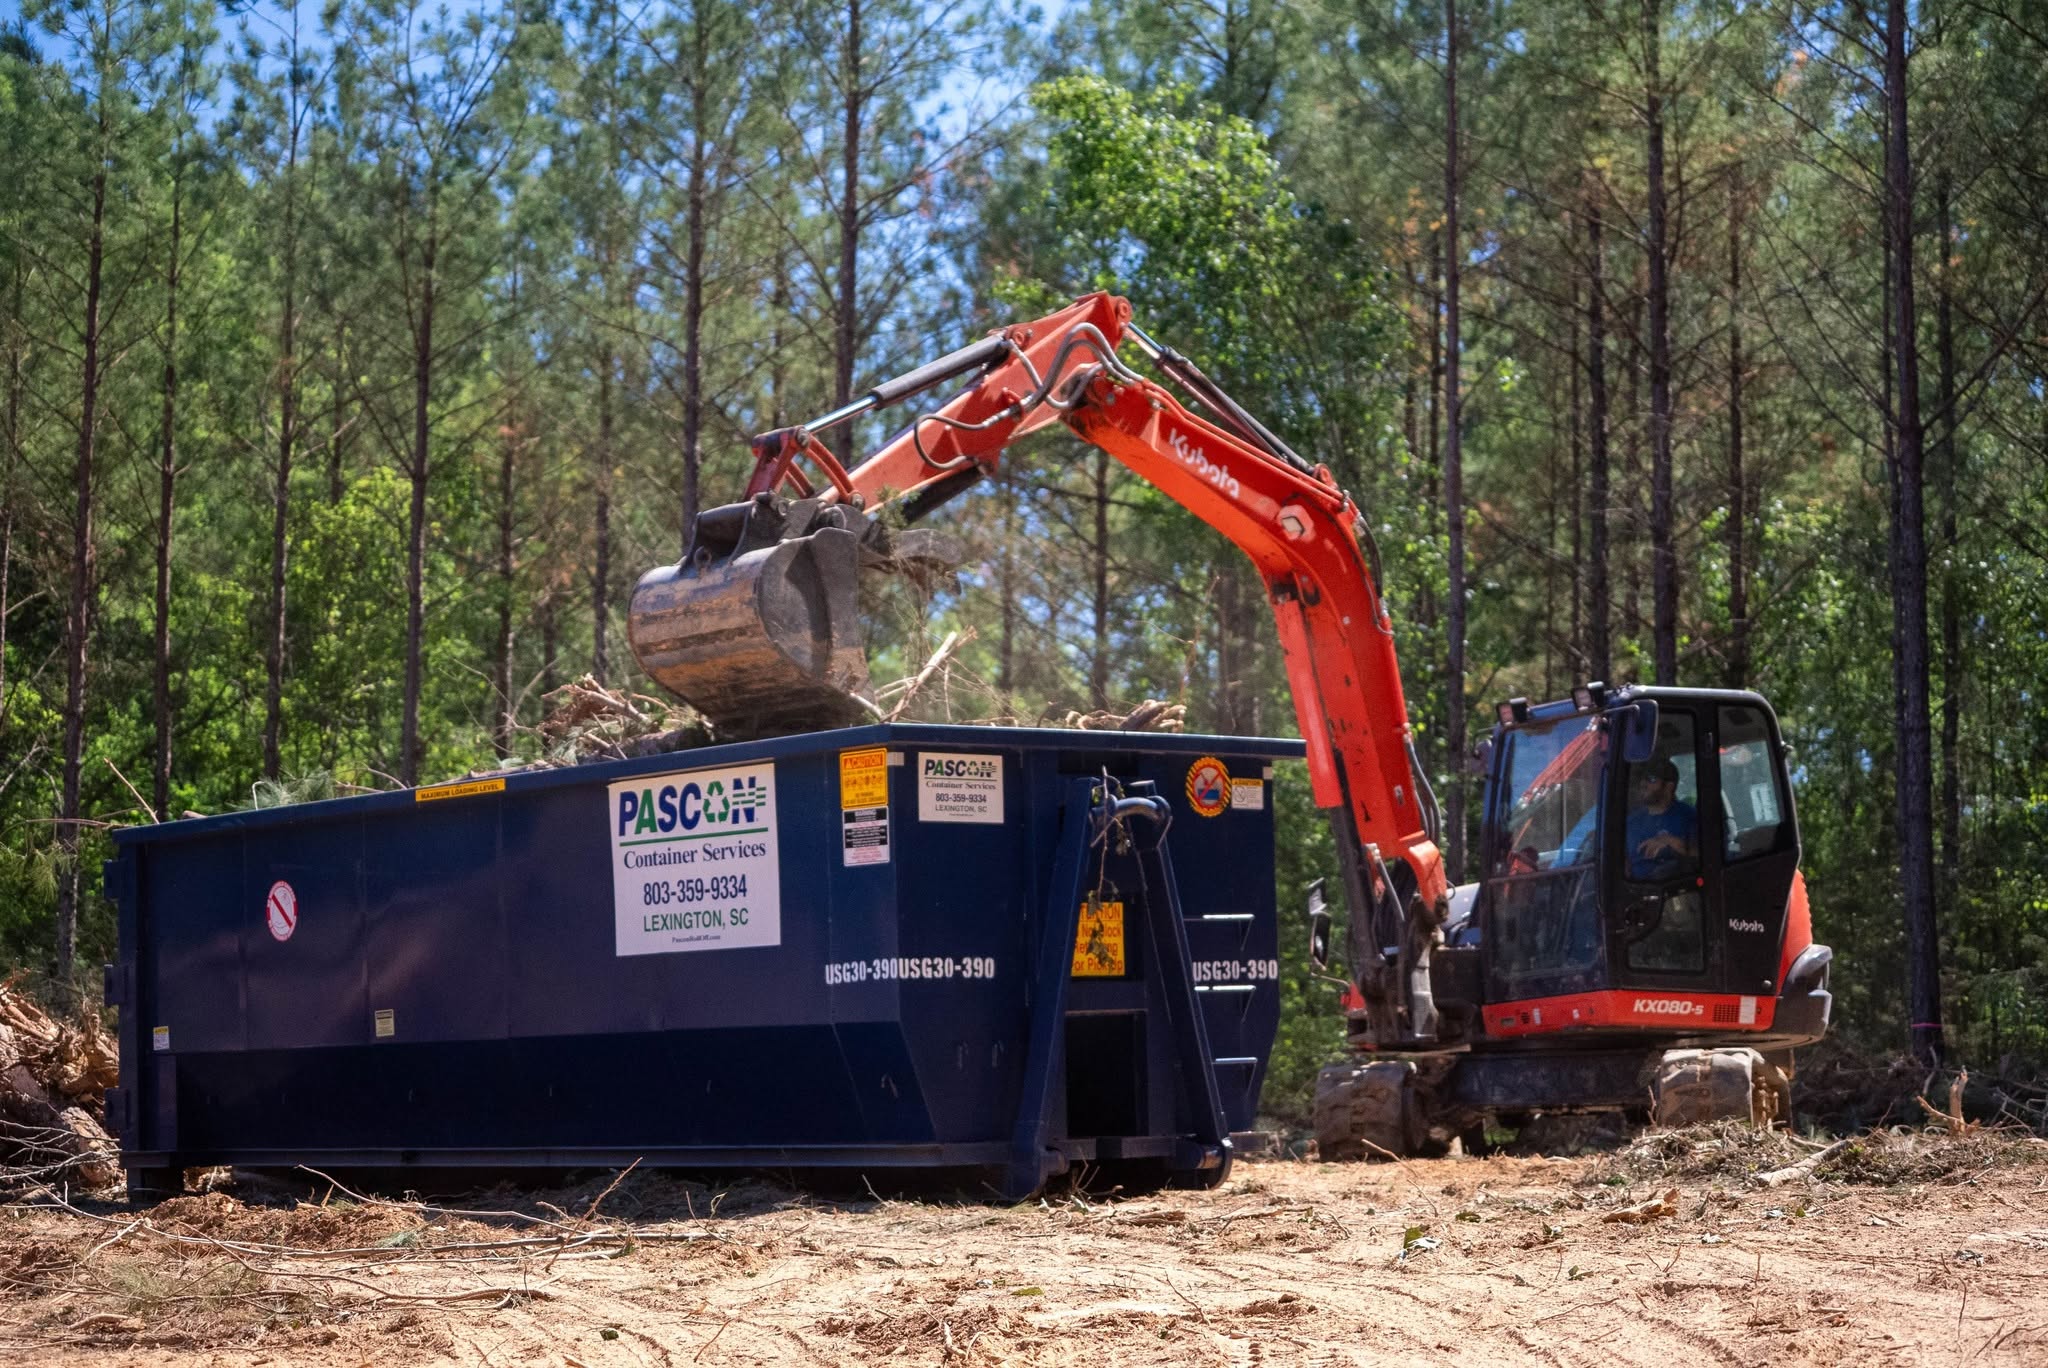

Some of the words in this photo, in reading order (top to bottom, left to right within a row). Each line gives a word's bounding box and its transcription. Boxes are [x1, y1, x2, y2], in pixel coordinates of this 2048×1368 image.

[1169, 427, 1240, 499] Kubota
[421, 790, 450, 799] MAXIMUM
[451, 786, 478, 796] LOADING
[479, 783, 499, 792] LEVEL
[926, 781, 962, 789] Container
[965, 782, 996, 790] Services
[935, 793, 987, 803] 803-359-9334
[977, 805, 988, 813] SC
[623, 847, 698, 869] Container
[702, 840, 766, 862] Services
[643, 874, 747, 906] 803-359-9334
[643, 910, 726, 933] LEXINGTON,
[729, 907, 749, 926] SC
[1728, 918, 1765, 933] Kubota
[825, 958, 898, 985] USG30-390
[899, 956, 995, 979] USG30-390
[1192, 959, 1279, 982] USG30-390
